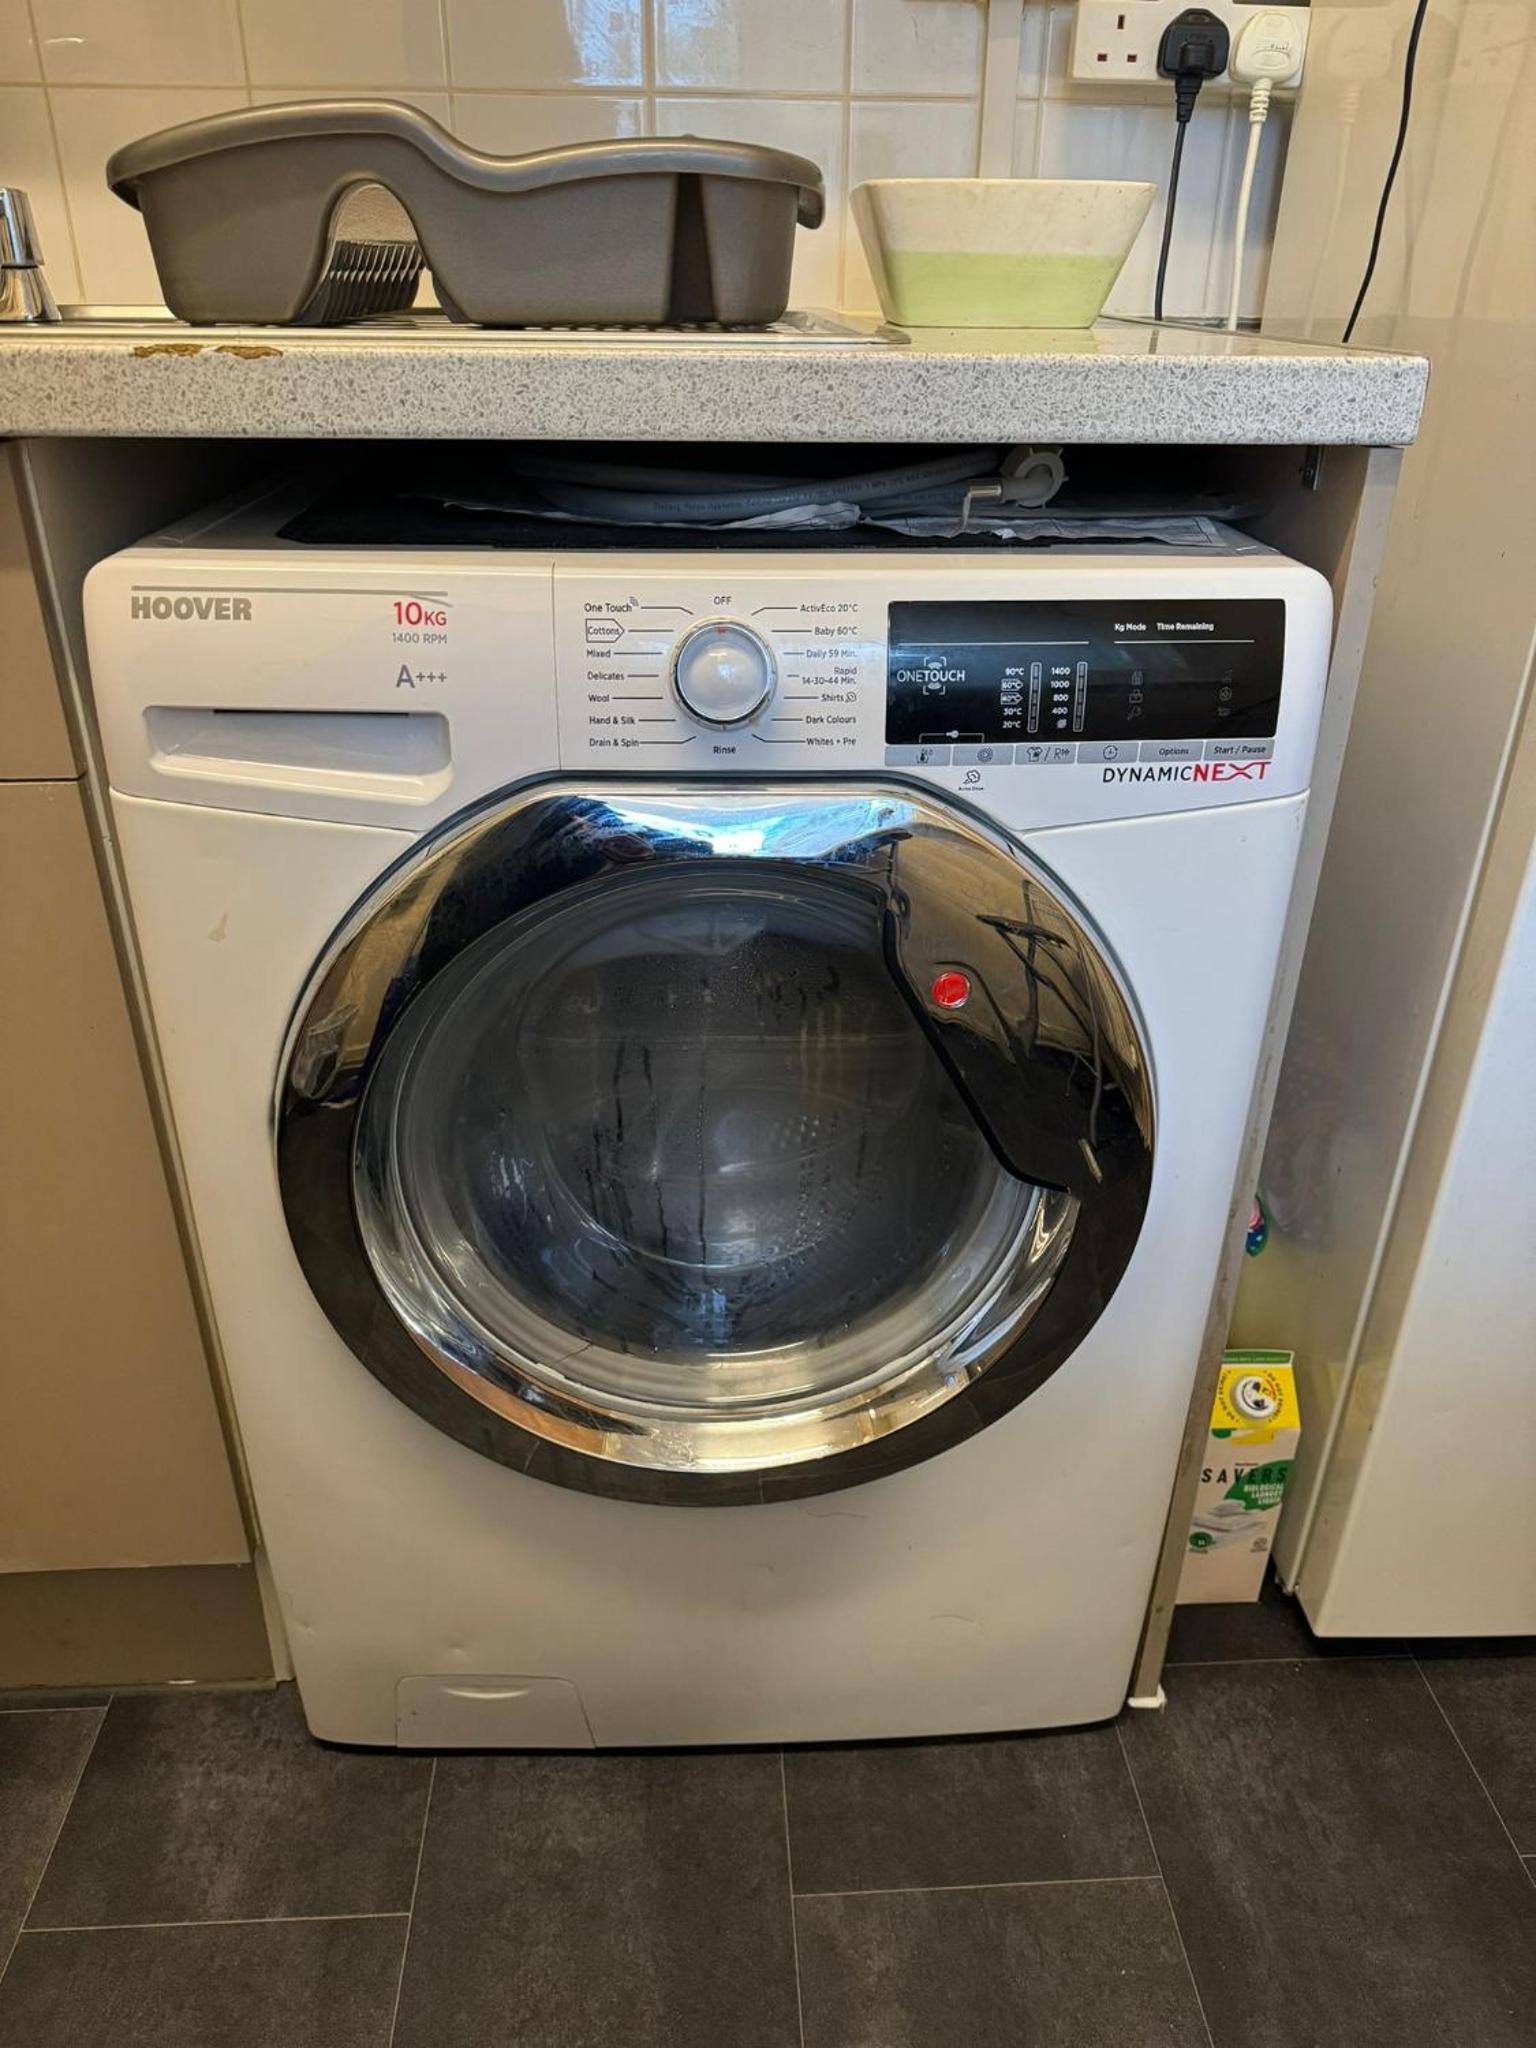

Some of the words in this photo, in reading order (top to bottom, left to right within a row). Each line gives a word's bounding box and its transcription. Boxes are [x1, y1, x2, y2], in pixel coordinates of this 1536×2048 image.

[713, 595, 732, 605] OFF
[131, 597, 252, 621] HOOVER
[584, 602, 603, 612] One
[605, 603, 632, 613] Touch
[393, 601, 447, 626] 10KG
[587, 626, 619, 635] Cottons
[1114, 623, 1125, 632] Kg
[1126, 623, 1147, 631] Mode
[1156, 622, 1175, 631] Time
[1176, 622, 1215, 631] Remaining
[815, 626, 835, 637] Baby
[392, 632, 420, 643] 1400
[422, 633, 448, 644] RPM
[586, 649, 611, 658] Mixed
[806, 650, 827, 659] Daily
[829, 650, 839, 658] 59
[834, 667, 857, 676] Rapid
[1051, 667, 1071, 675] 1400
[396, 664, 447, 688] A+++
[587, 672, 624, 680] Delicates
[897, 670, 966, 682] ONETOUCH
[802, 677, 839, 685] 14-30-44
[1050, 680, 1070, 688] 1000
[588, 694, 610, 702] Wool
[821, 693, 845, 702] Shirts
[1053, 694, 1069, 702] 800
[589, 716, 611, 724] Hand
[612, 716, 619, 724] &
[621, 715, 635, 724] Silk
[806, 715, 824, 724] Dark
[827, 715, 857, 724] Colours
[589, 738, 611, 747] Drain
[613, 738, 619, 747] &
[621, 738, 639, 749] Spin
[806, 737, 834, 746] Whites
[843, 737, 857, 745] Pre
[713, 746, 737, 755] Rinse
[1159, 748, 1189, 756] Options
[1214, 746, 1233, 754] Start
[1242, 746, 1267, 754] Pause
[1201, 1467, 1288, 1485] SAVERS
